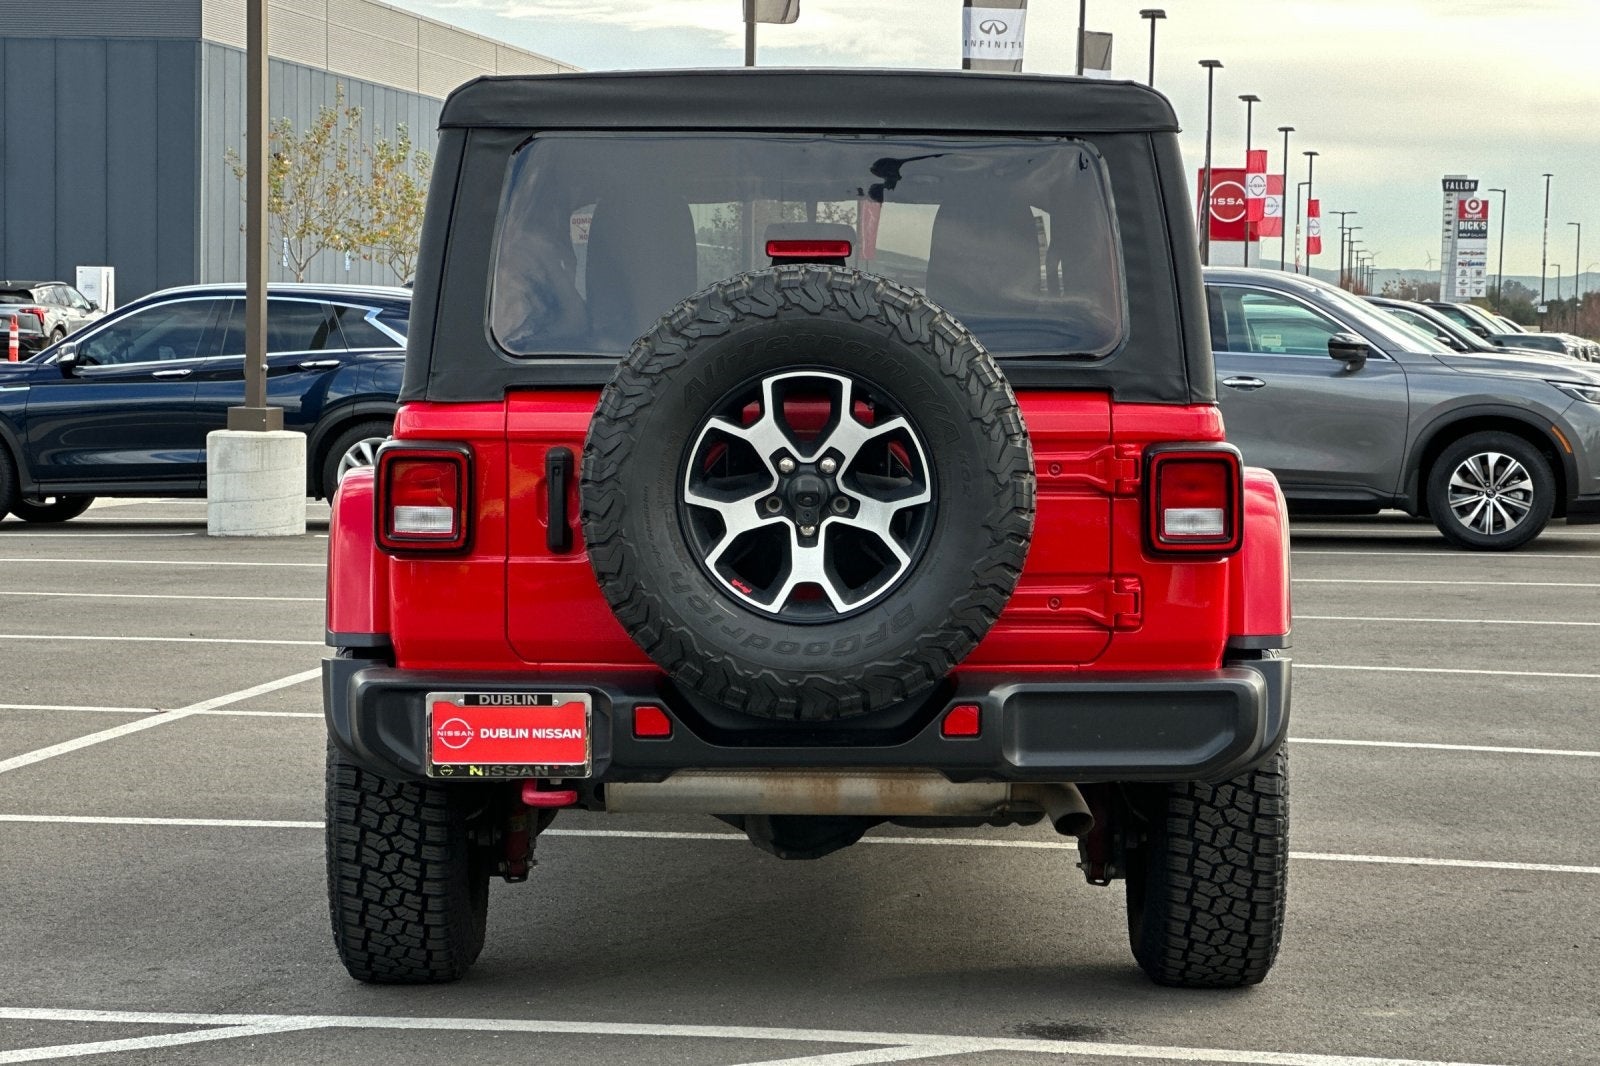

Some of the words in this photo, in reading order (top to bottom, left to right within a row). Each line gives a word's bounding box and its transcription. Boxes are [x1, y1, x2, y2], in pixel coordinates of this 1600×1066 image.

[964, 40, 1022, 48] INFINITI
[1445, 181, 1475, 190] FALLON
[1459, 221, 1487, 230] DICK'S
[670, 571, 917, 657] BFGoodrich
[479, 694, 538, 705] DUBLIN
[480, 728, 529, 739] DUBLIN
[532, 728, 581, 739] NISSAN
[469, 765, 548, 776] NISSAN
